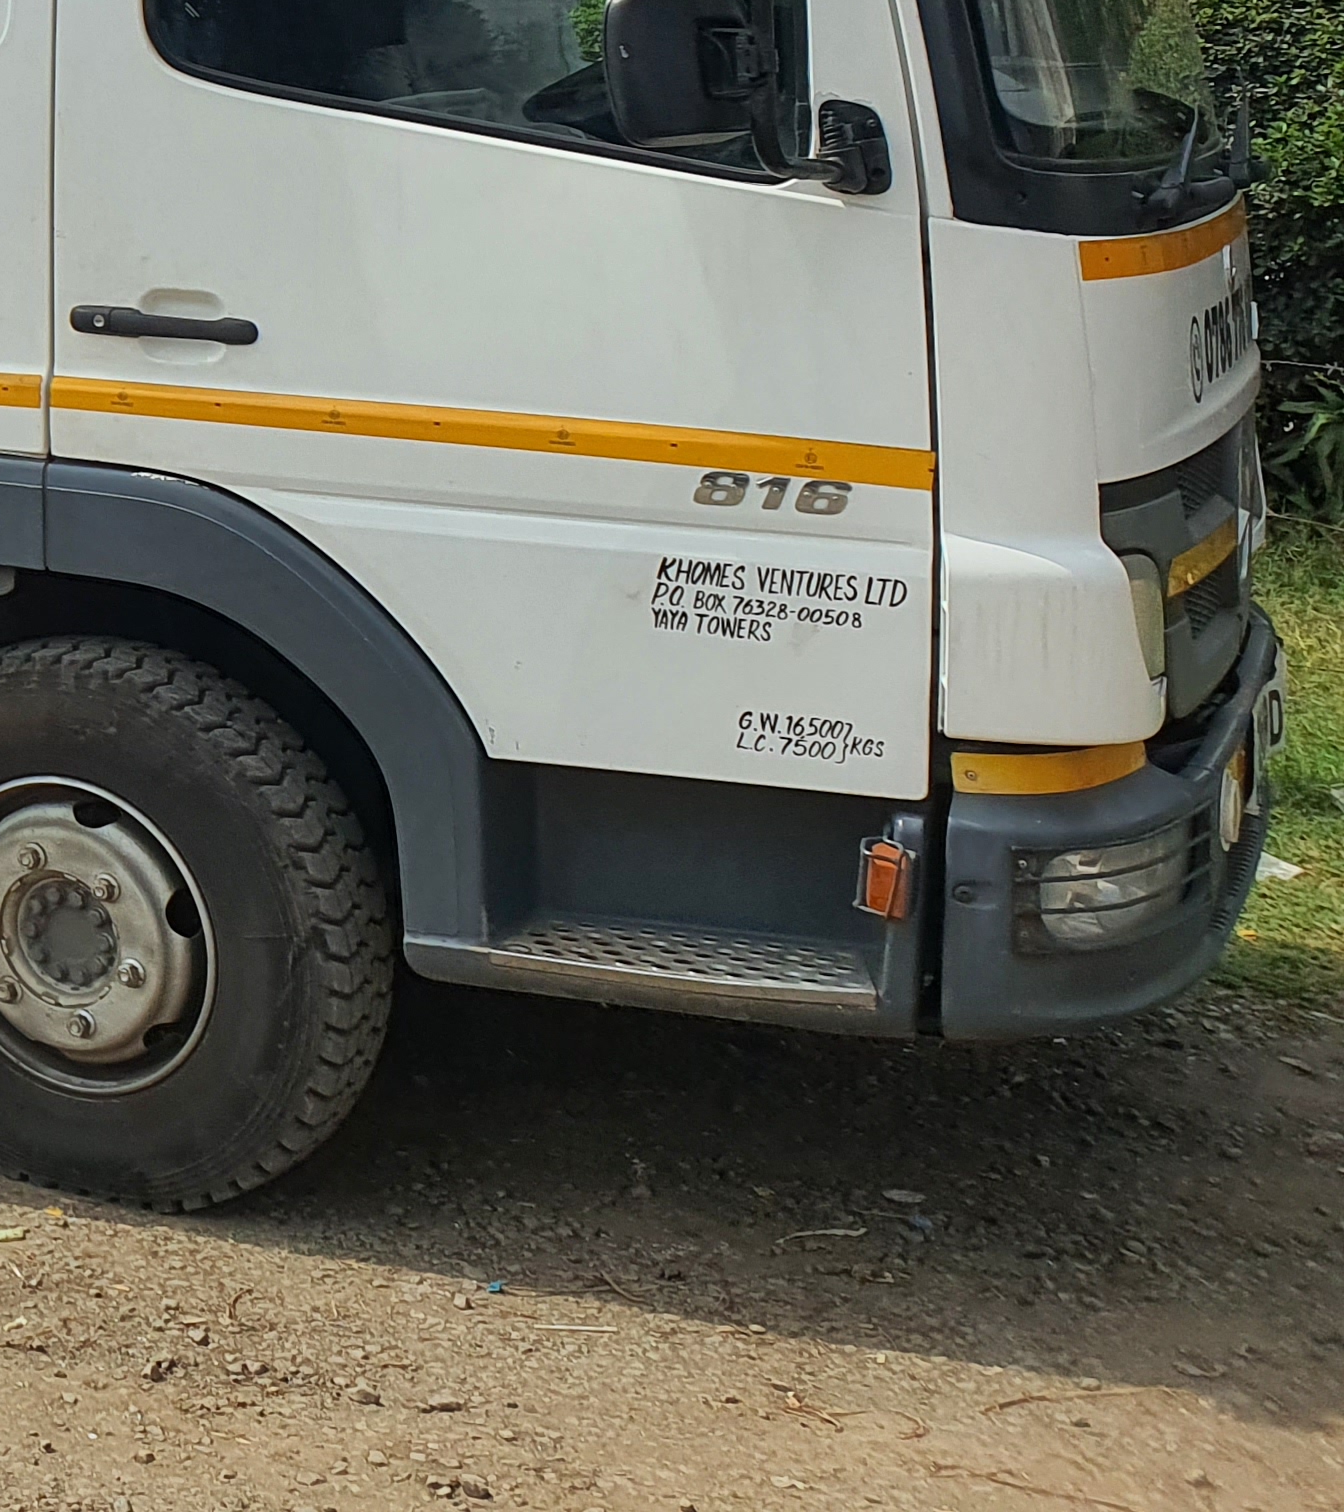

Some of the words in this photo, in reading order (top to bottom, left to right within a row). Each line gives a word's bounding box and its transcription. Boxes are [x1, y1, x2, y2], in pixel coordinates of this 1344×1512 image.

[692, 471, 853, 516] 816
[651, 581, 686, 608] P.O.
[692, 590, 727, 615] BOX
[732, 595, 863, 629] 76328-00508
[656, 556, 746, 591] KHOMES
[757, 566, 859, 602] VENTURES
[864, 576, 908, 608] LTD
[651, 607, 689, 632] YAYA
[694, 613, 773, 642] TOWERS
